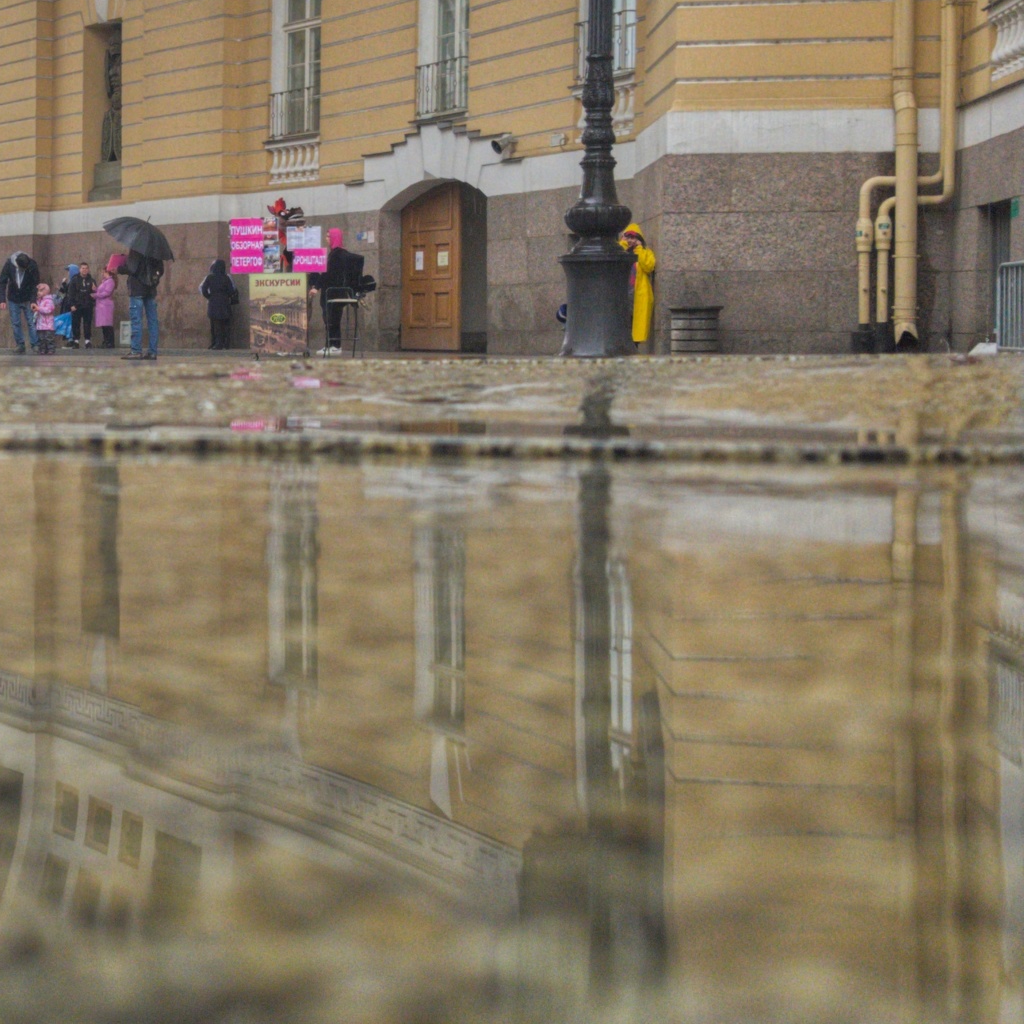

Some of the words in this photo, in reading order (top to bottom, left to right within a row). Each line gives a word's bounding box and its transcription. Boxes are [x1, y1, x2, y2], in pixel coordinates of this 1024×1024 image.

[230, 224, 263, 236] ПУШКИН
[231, 240, 264, 250] ОБЗОРНАЯ
[231, 256, 263, 267] ПЕТЕРГОФ
[255, 279, 301, 287] ЭКСКУРСИИ
